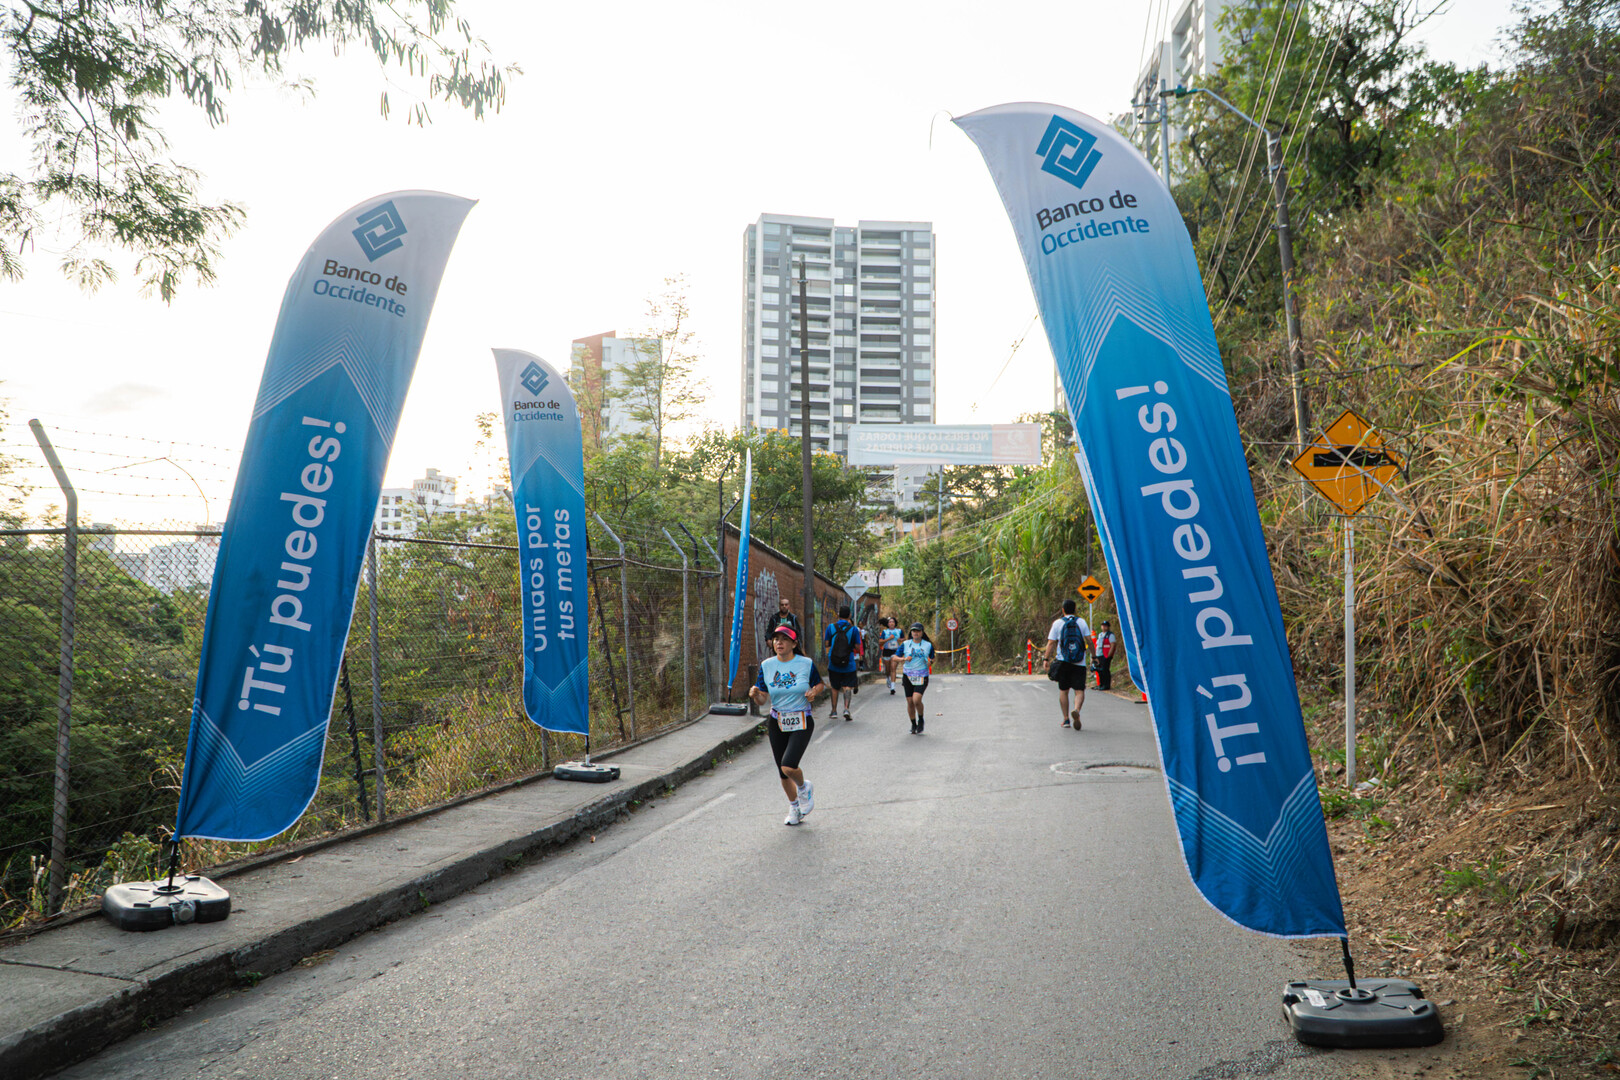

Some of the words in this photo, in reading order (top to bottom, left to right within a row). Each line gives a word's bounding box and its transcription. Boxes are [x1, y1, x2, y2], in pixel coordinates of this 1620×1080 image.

[1036, 198, 1104, 231] Banco
[1109, 190, 1137, 209] de
[1041, 216, 1150, 256] Occidente
[323, 259, 381, 285] Banco
[385, 275, 408, 296] de
[313, 279, 406, 318] Occidente
[513, 411, 564, 422] Occidente
[514, 401, 545, 410] Banco
[547, 400, 560, 409] de
[526, 503, 549, 549] por
[1115, 380, 1254, 649] puedes!
[238, 643, 294, 716] ¡Tú
[269, 415, 346, 632] puedes!
[553, 509, 573, 592] metas
[557, 600, 575, 640] tus
[782, 717, 800, 726] 4023
[1196, 673, 1267, 773] ¡Tú
